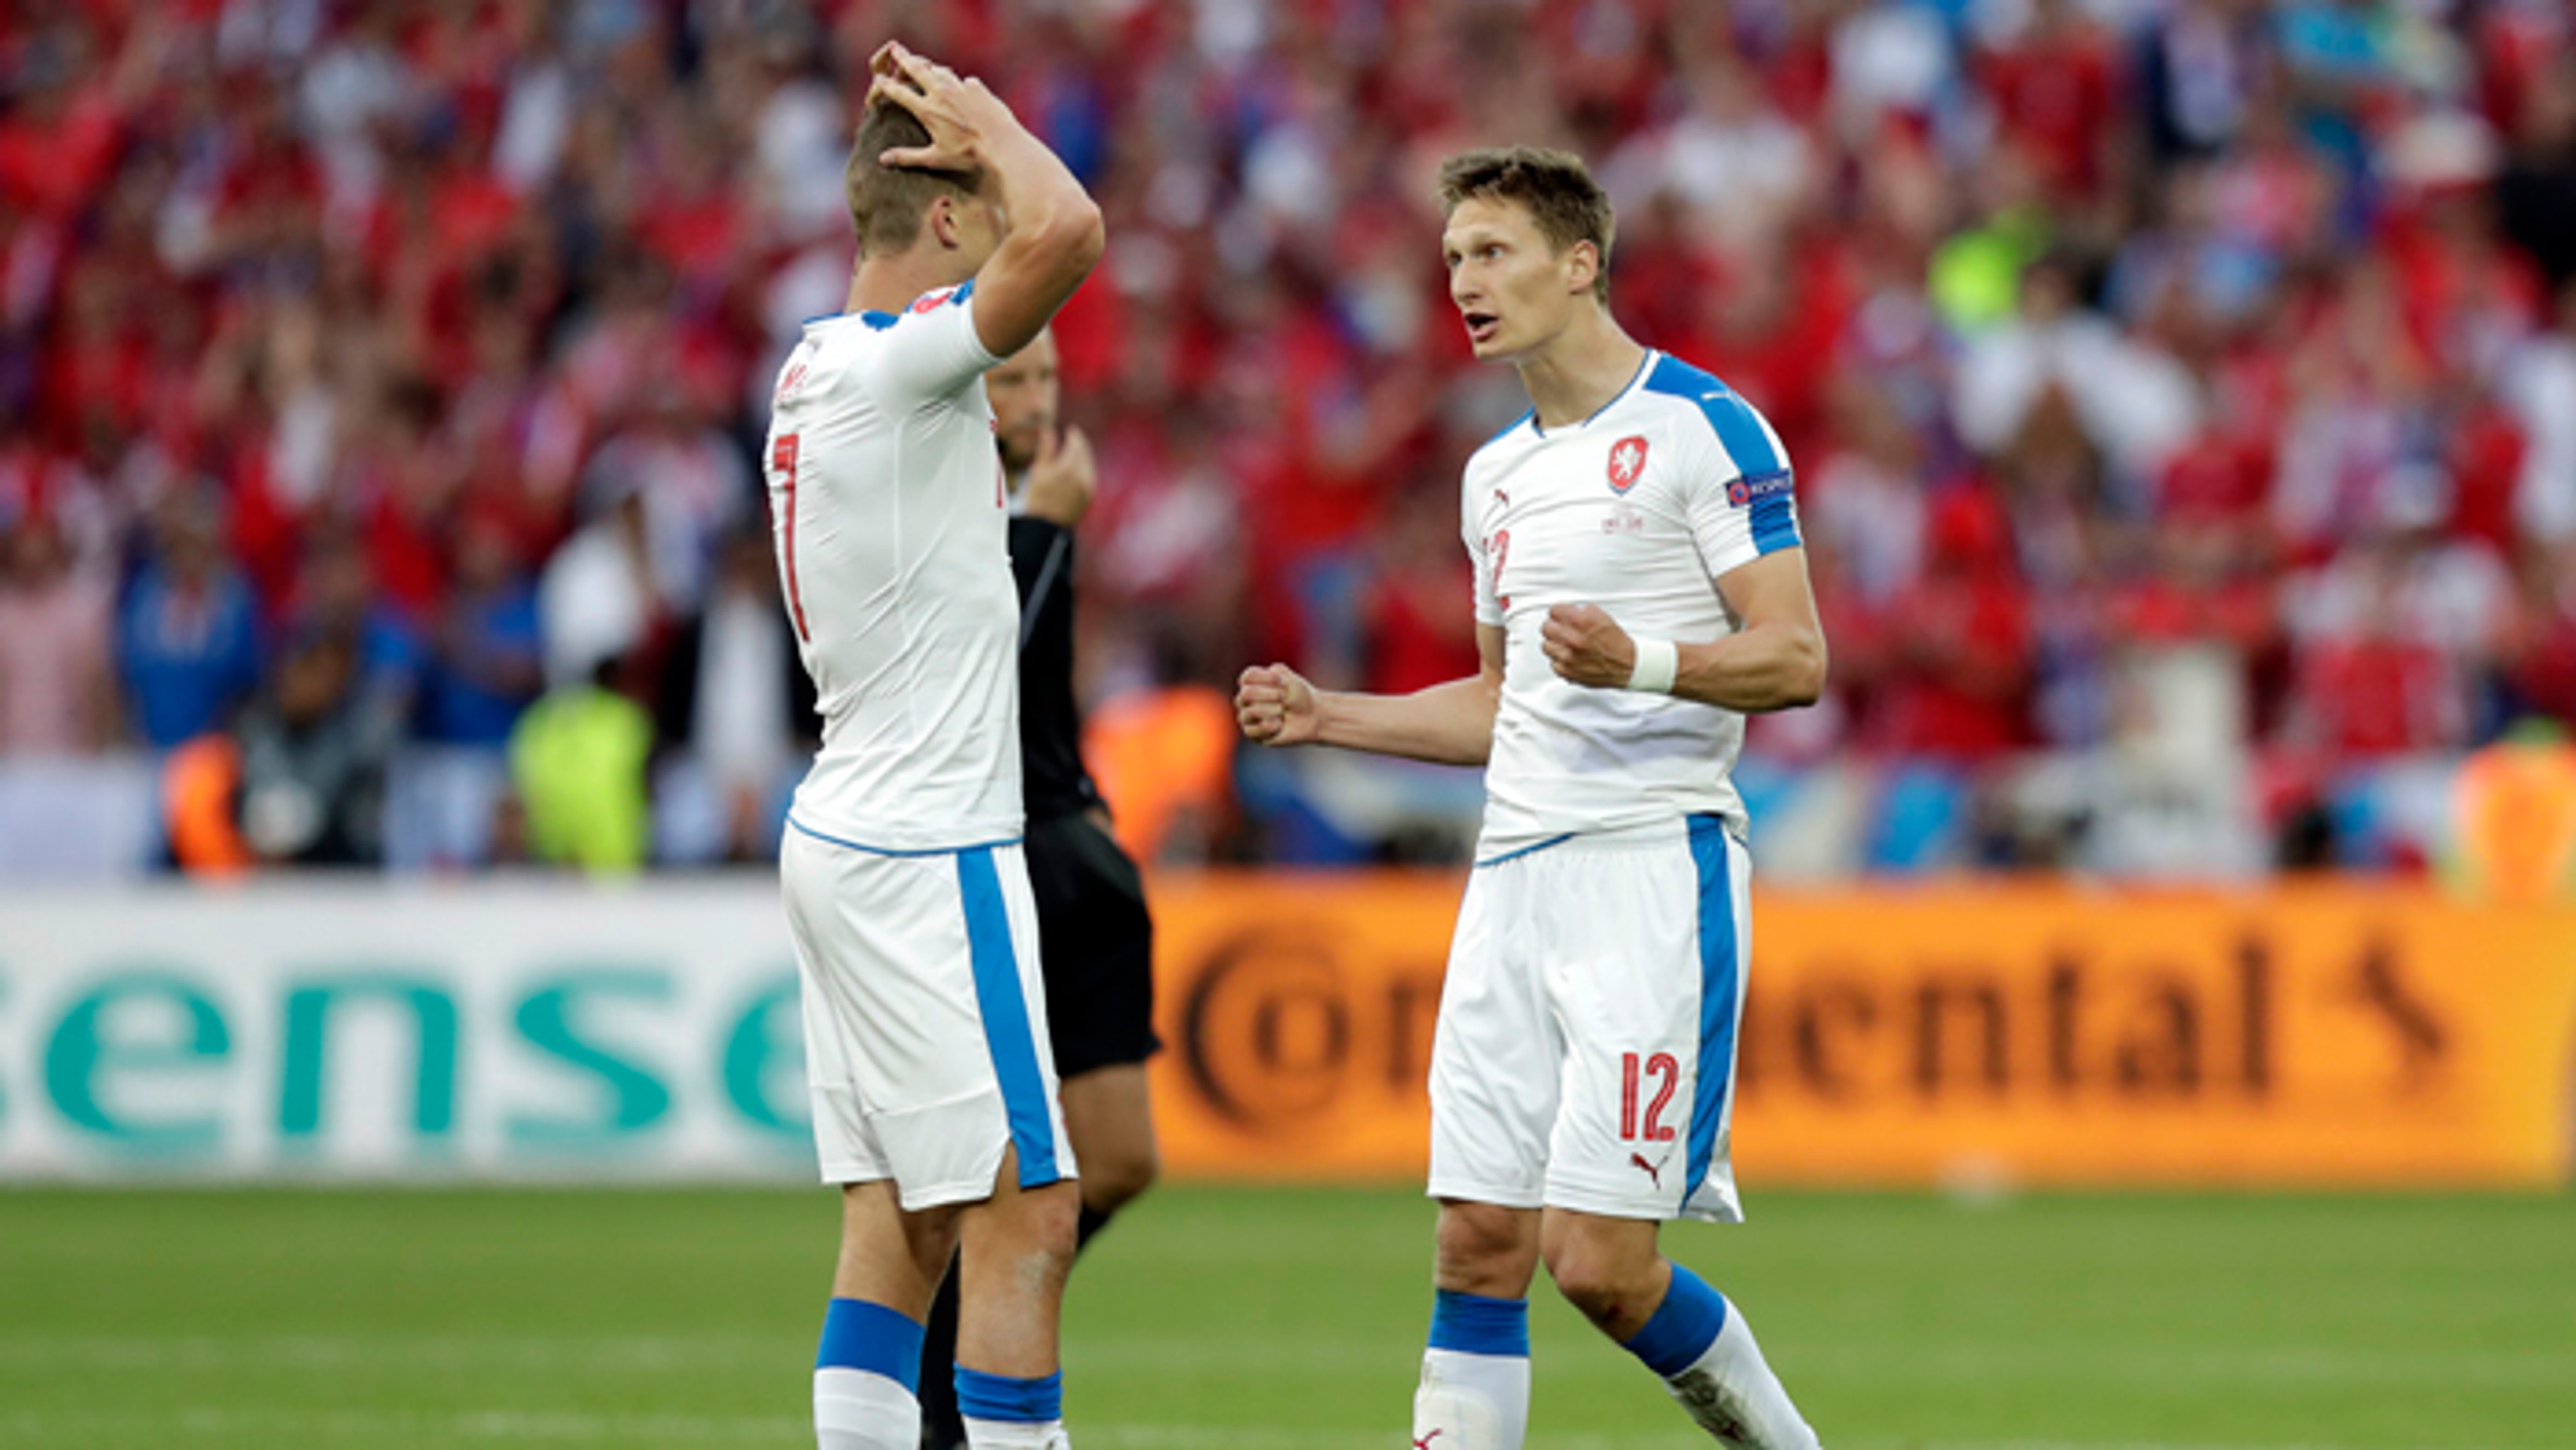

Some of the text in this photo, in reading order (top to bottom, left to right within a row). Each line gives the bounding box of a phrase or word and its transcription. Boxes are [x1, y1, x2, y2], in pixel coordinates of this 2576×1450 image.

[1482, 530, 1510, 612] 2
[0, 961, 818, 1148] ense
[1620, 1052, 1679, 1141] 12
